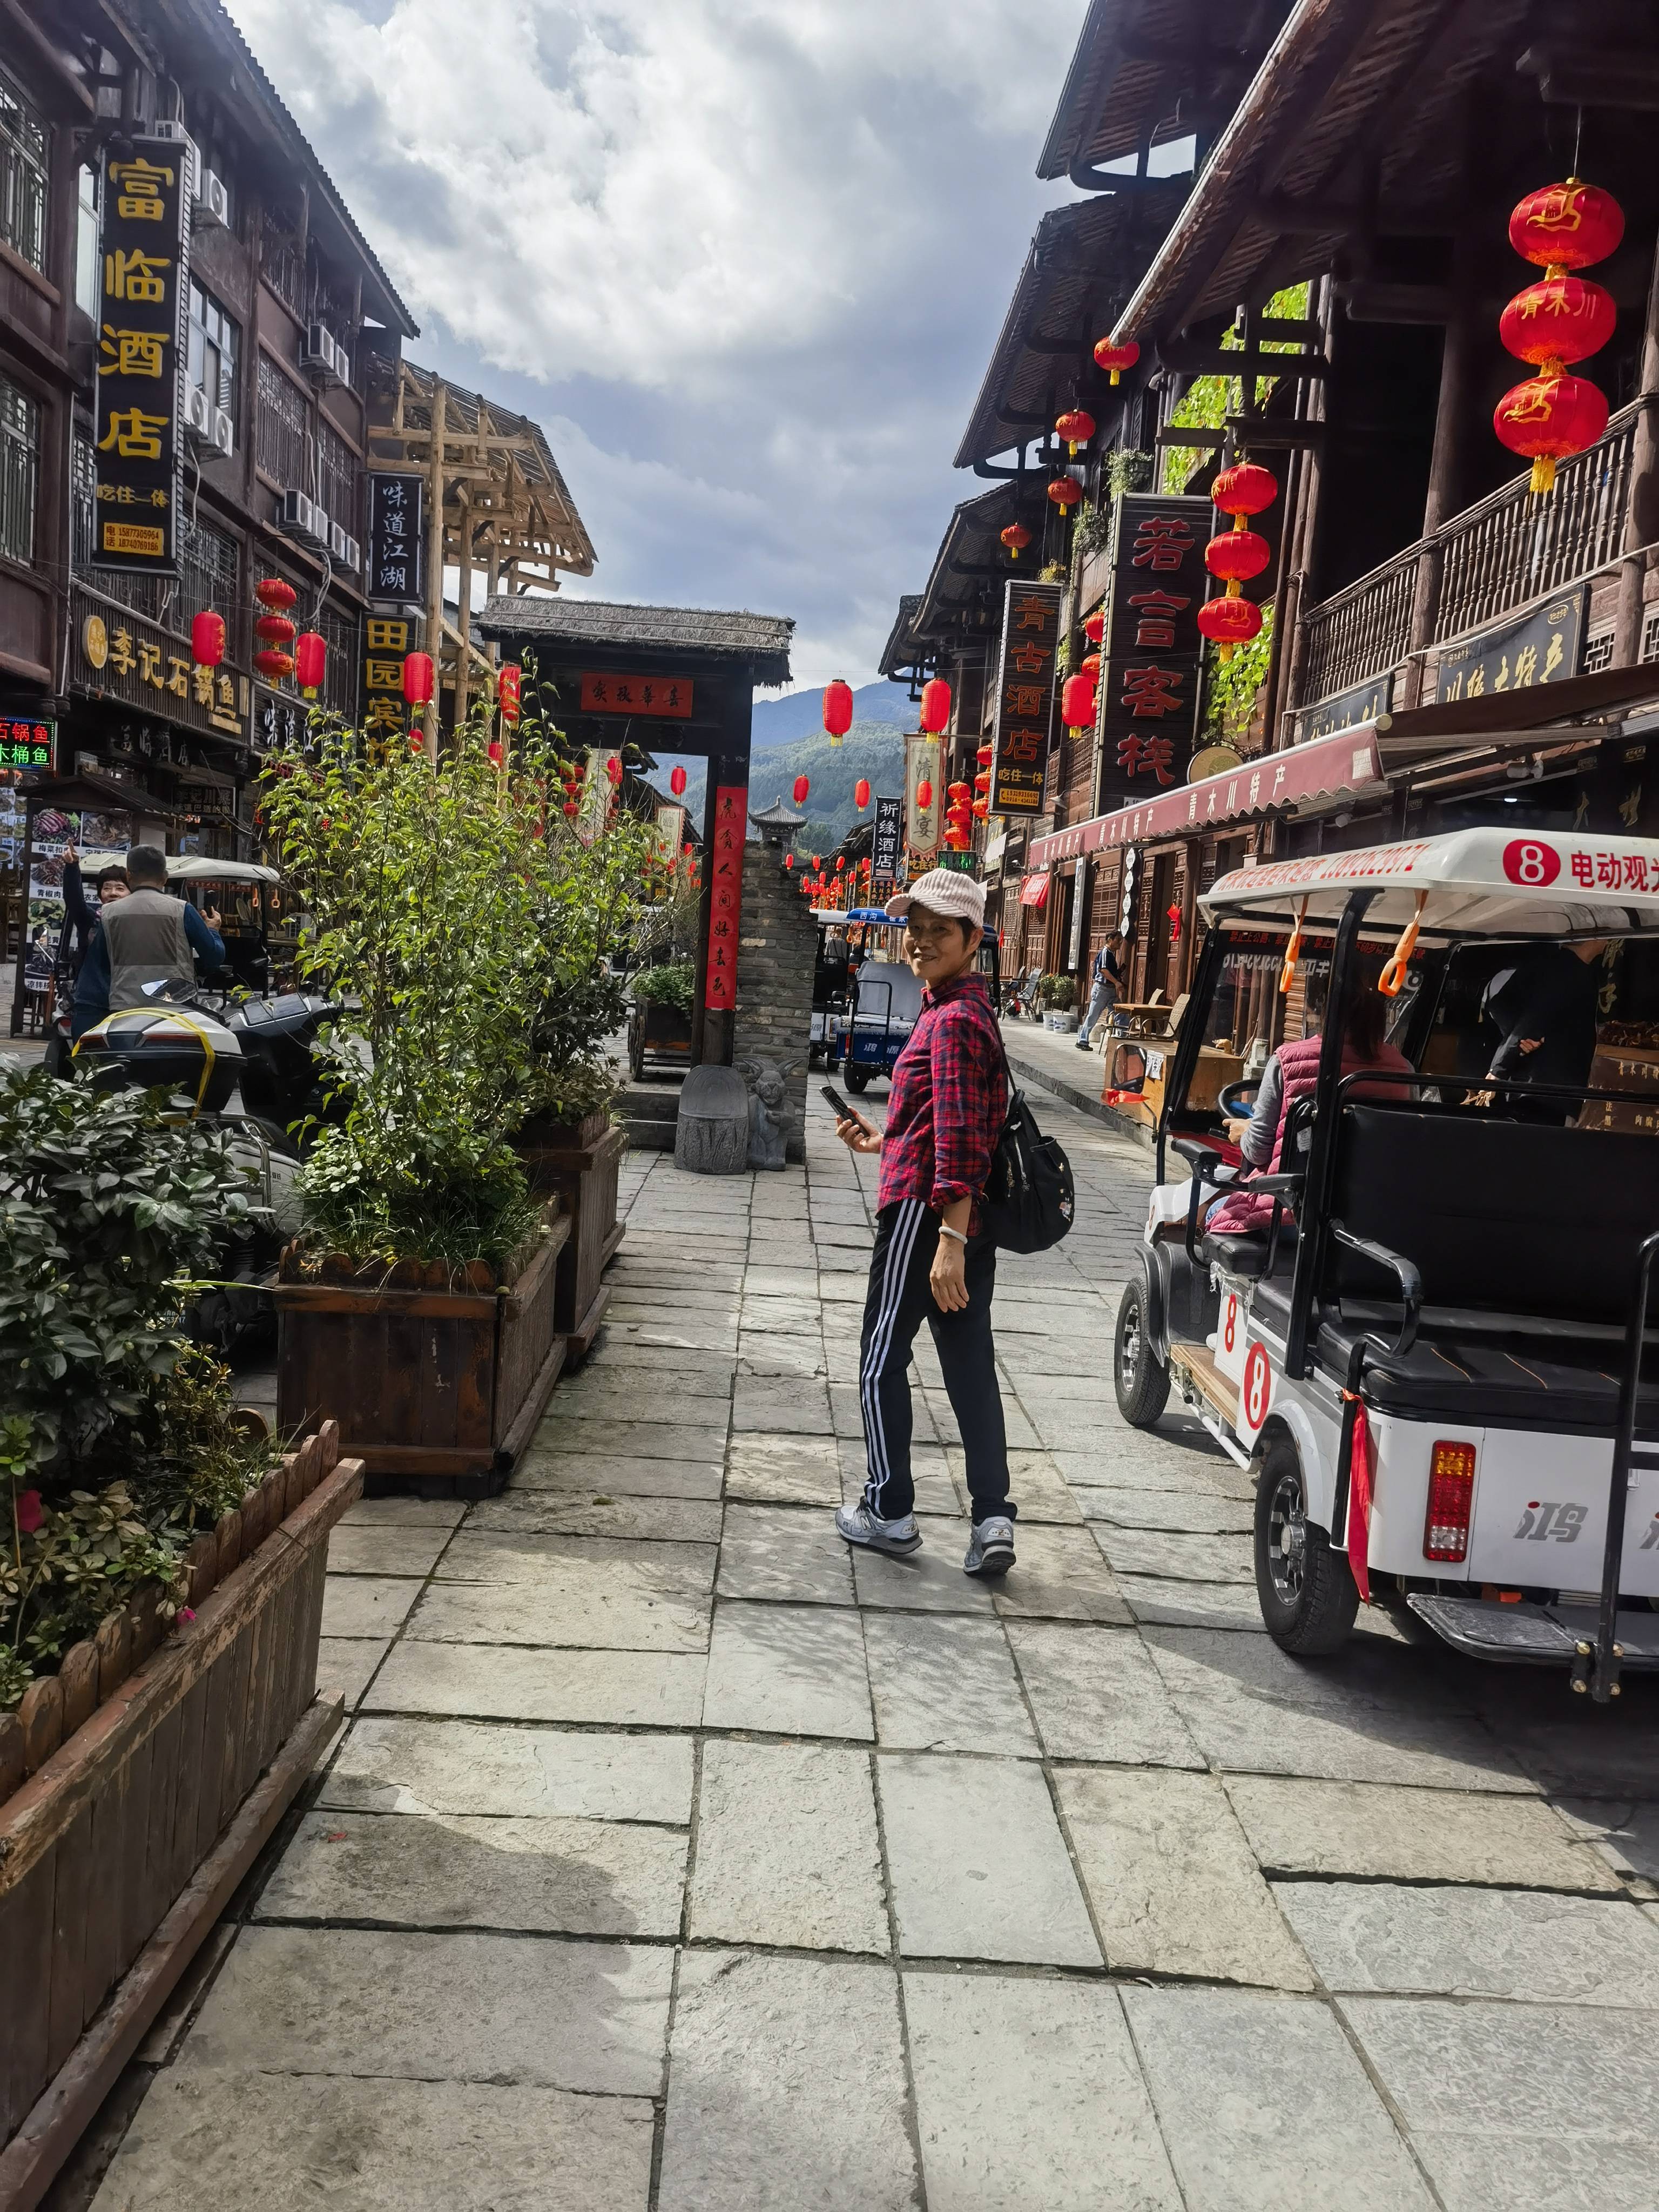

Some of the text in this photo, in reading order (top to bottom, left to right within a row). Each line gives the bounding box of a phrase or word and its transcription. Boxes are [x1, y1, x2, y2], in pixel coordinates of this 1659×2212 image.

[98, 158, 174, 460] 富临酒店
[97, 484, 170, 508] 吃住一体
[380, 481, 409, 591] 味道江湖
[1002, 595, 1055, 762] 青古酒店
[1117, 516, 1195, 786] 若言客栈
[913, 757, 934, 839] 清宴
[998, 767, 1043, 785] 吃住一体
[1189, 764, 1286, 820] 青木川特产
[875, 802, 899, 868] 祈缘酒店
[1099, 807, 1154, 844] 青木川特产
[1519, 845, 1545, 882] 8
[37, 889, 64, 899] 青椒肉
[1149, 1204, 1155, 1231] 8
[1225, 1293, 1237, 1353] 8
[1250, 1351, 1264, 1422] 8
[860, 1516, 873, 1530] N
